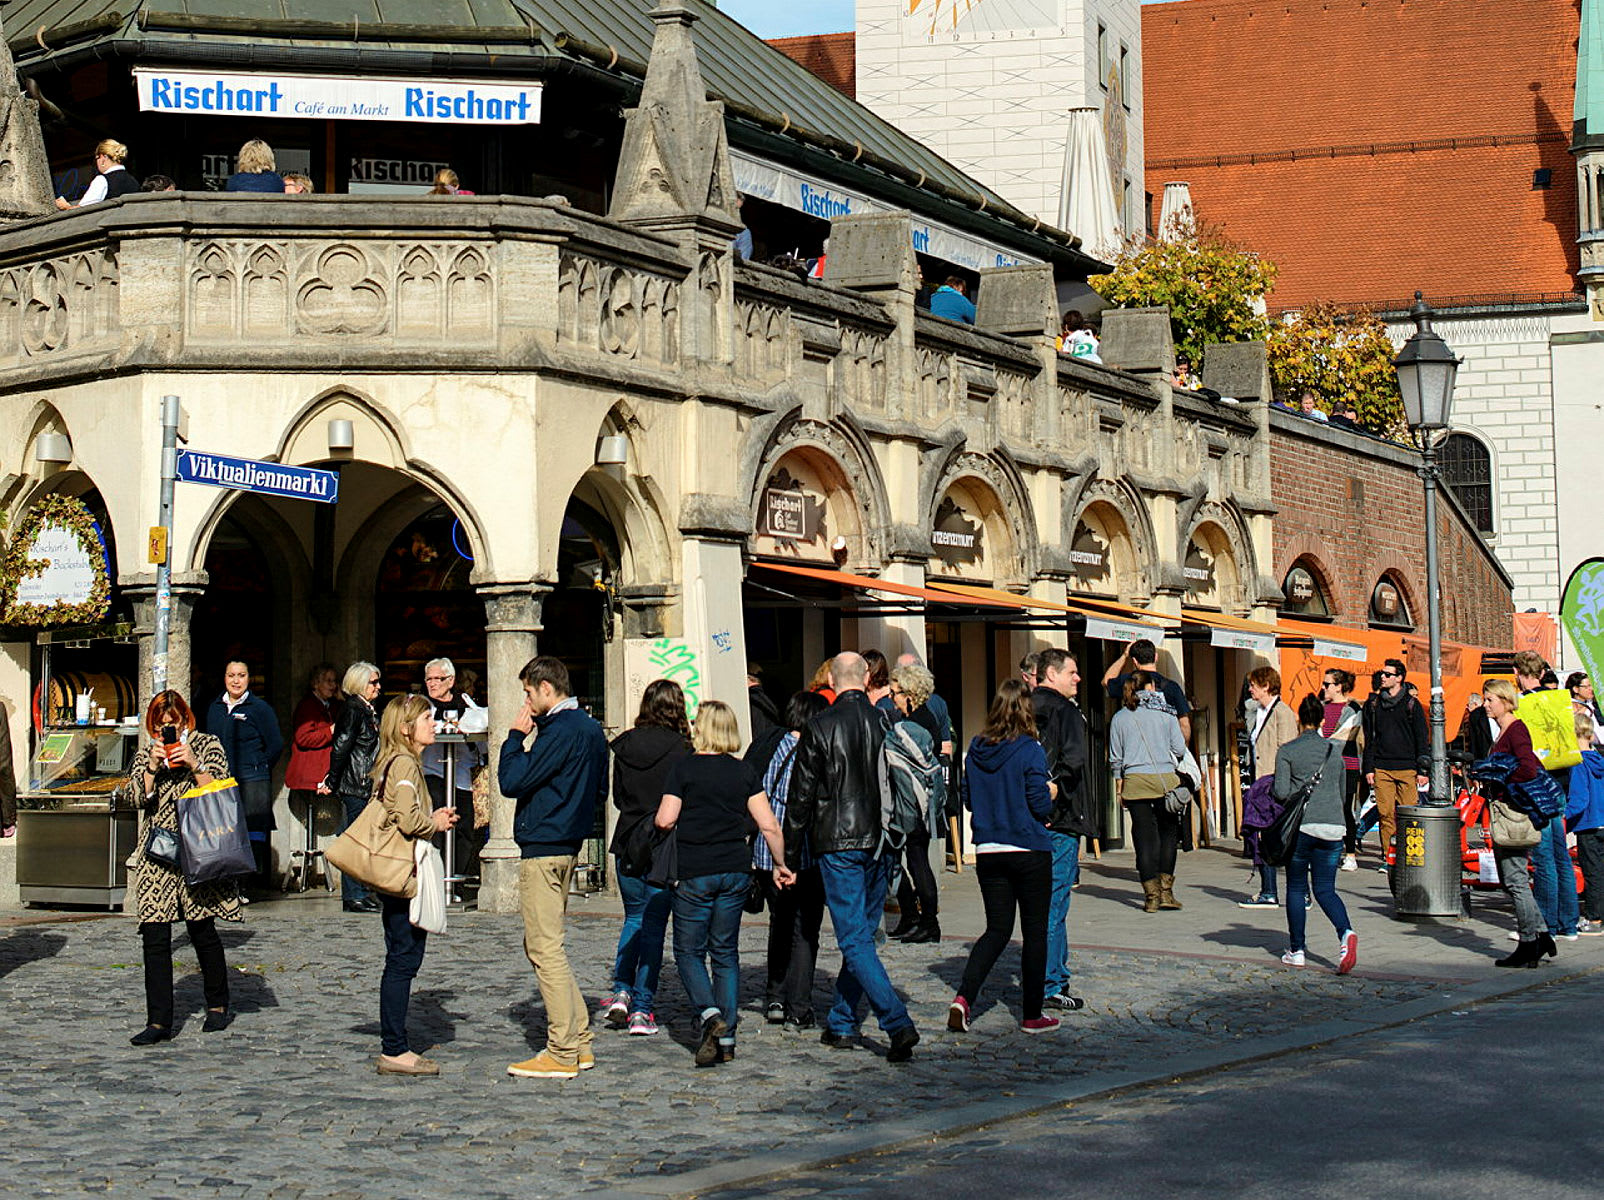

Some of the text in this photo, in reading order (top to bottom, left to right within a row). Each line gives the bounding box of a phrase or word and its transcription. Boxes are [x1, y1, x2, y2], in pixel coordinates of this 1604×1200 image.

[151, 78, 532, 121] Rischart Café am Markt Rischart
[801, 183, 852, 219] Rischart
[188, 454, 328, 496] Viktualienmarkt
